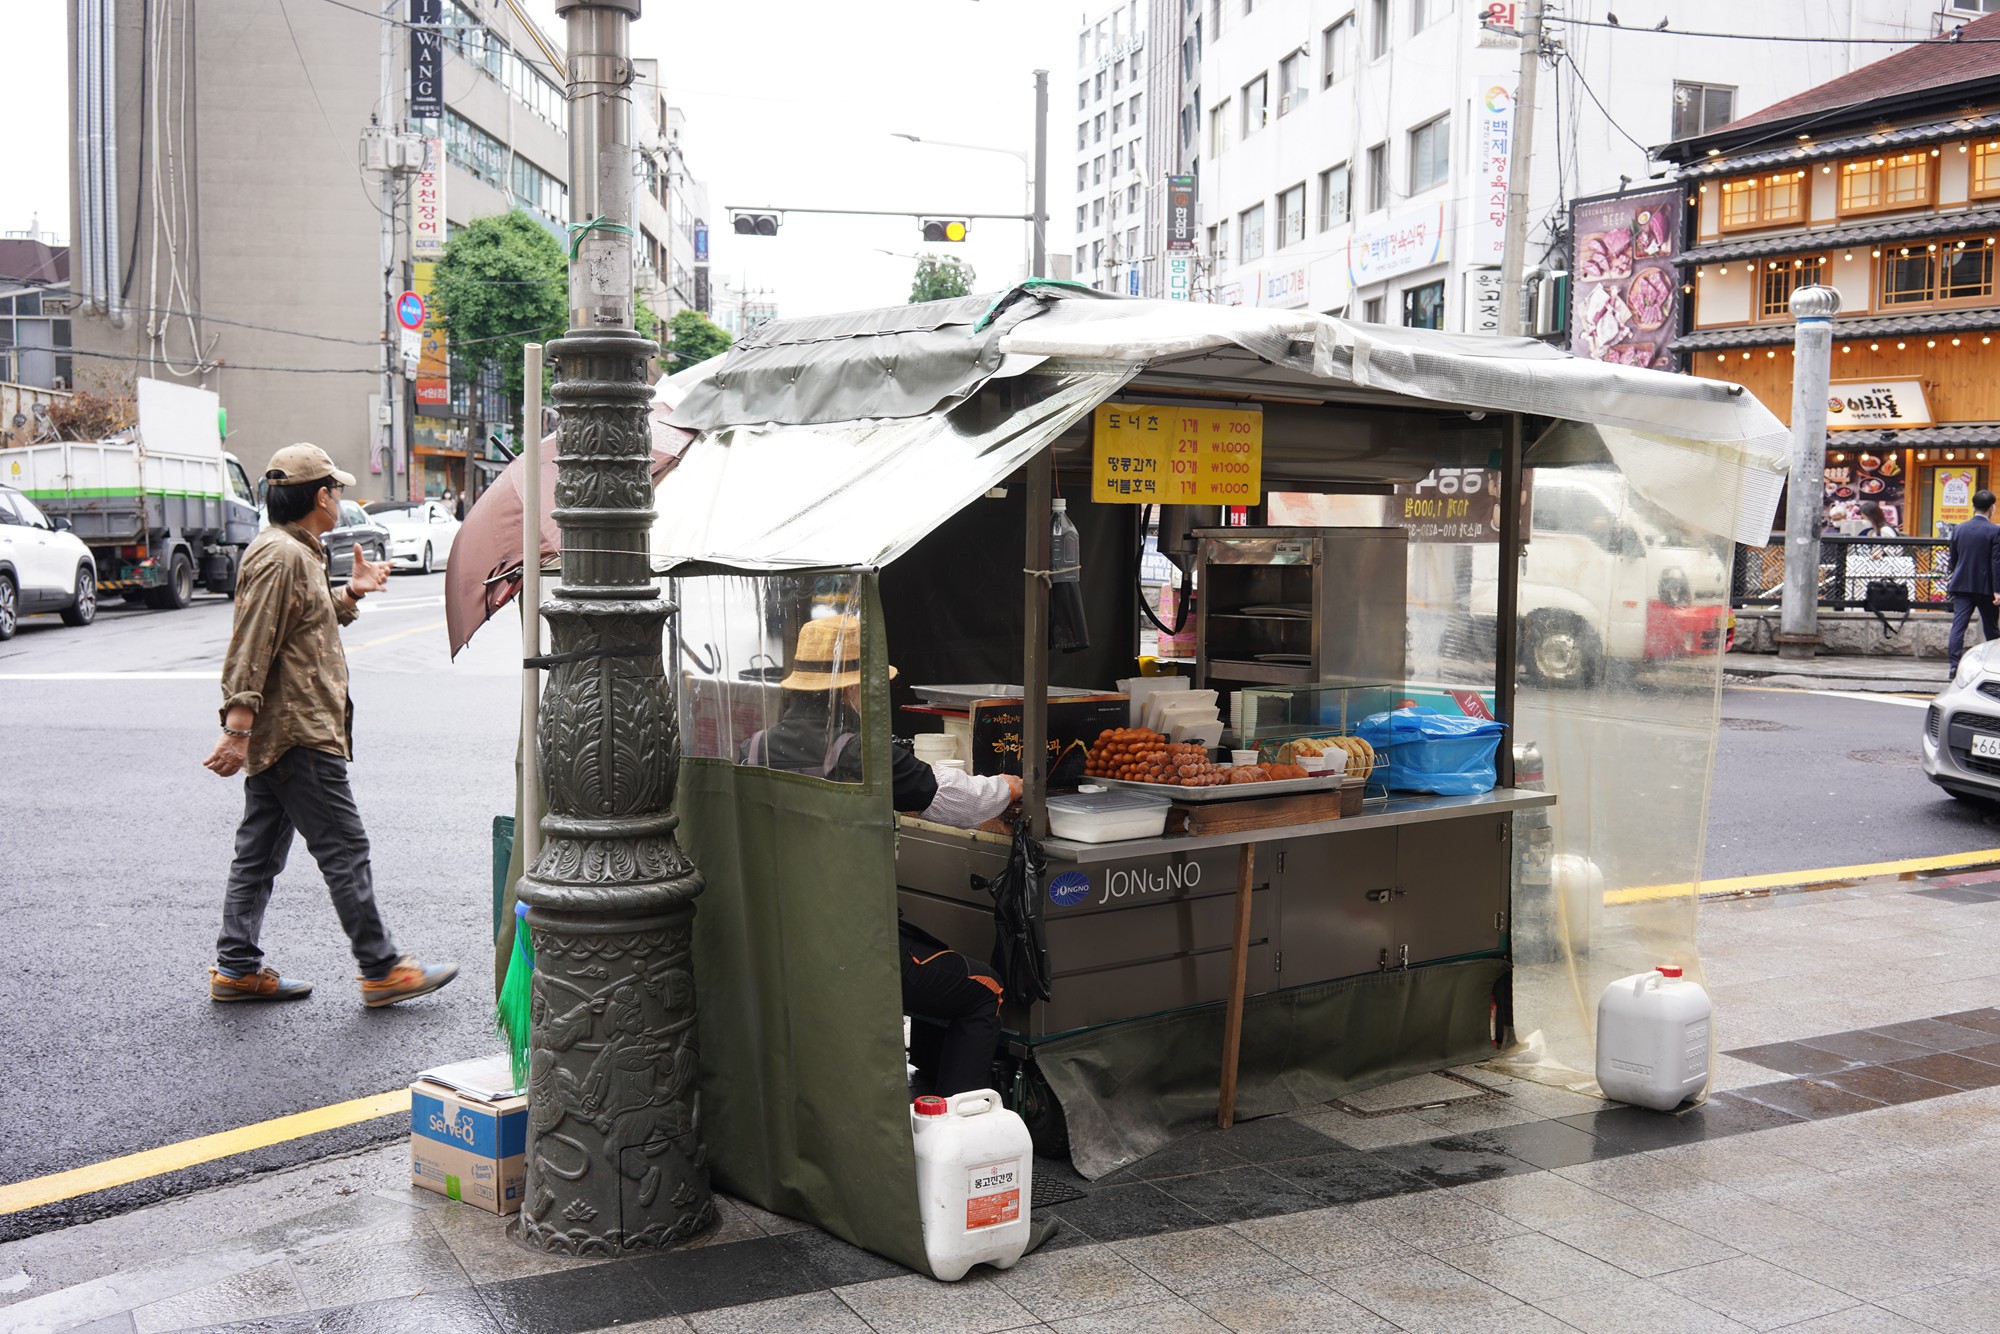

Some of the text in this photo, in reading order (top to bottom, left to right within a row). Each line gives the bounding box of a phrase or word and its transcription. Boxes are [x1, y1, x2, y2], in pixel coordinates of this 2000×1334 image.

[1490, 120, 1508, 227] 백제정육식당
[1602, 212, 1625, 227] BEEF
[1371, 222, 1426, 260] 백제정육식당
[1847, 394, 1902, 418] 이차돌
[1182, 419, 1198, 433] 1개
[1229, 422, 1250, 434] 700
[1179, 440, 1198, 454] 2개
[1108, 457, 1157, 473] 땅콩과자
[1171, 459, 1198, 474] 10개
[1107, 478, 1156, 495] 버블호떡
[1181, 481, 1197, 495] 1개
[1055, 884, 1090, 897] JONGNO
[1099, 861, 1200, 904] JONGNO
[429, 1114, 475, 1147] ServeQ
[975, 1171, 1014, 1189] 몽고진간장
